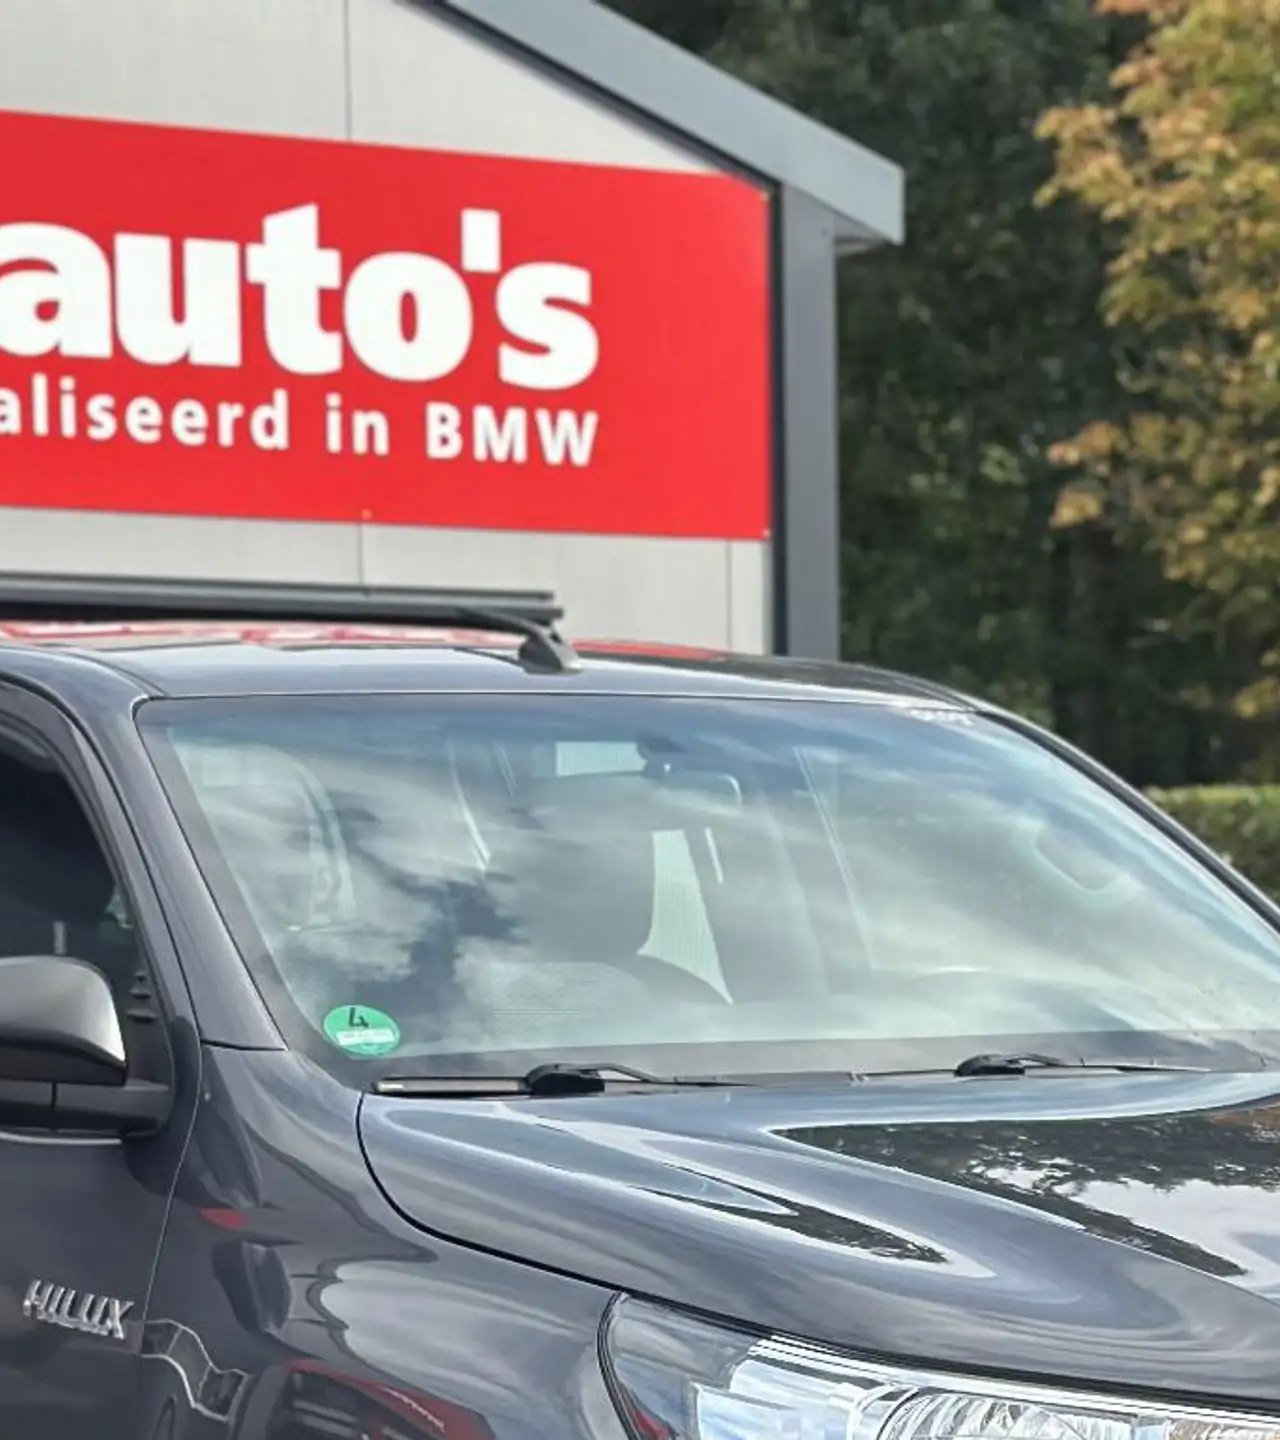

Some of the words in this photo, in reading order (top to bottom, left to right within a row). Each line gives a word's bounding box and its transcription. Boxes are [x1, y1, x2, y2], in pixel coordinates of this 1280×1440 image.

[326, 394, 389, 455] in
[426, 402, 598, 466] BMW
[347, 1006, 370, 1029] 4
[22, 1278, 135, 1340] HILUX
